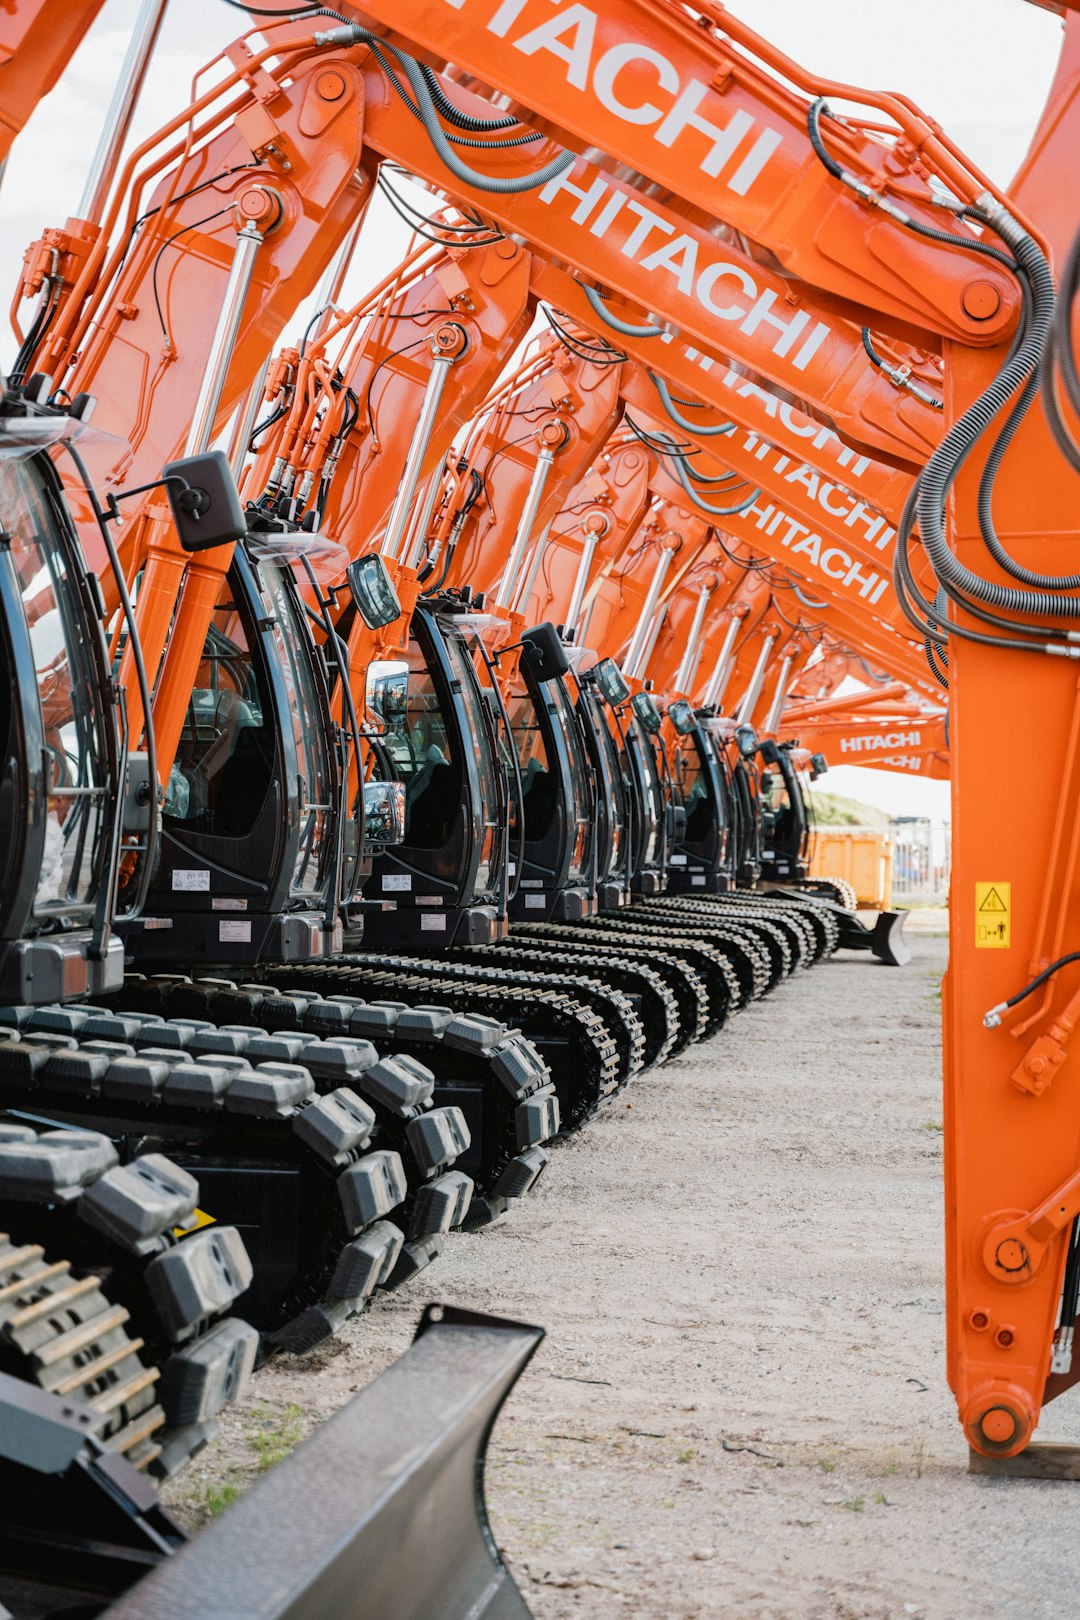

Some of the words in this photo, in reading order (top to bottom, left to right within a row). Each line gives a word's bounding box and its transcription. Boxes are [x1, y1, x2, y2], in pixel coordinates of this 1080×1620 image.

[538, 160, 831, 371] HITACHI
[738, 499, 889, 605] HITACHI
[840, 731, 921, 752] HITACHI
